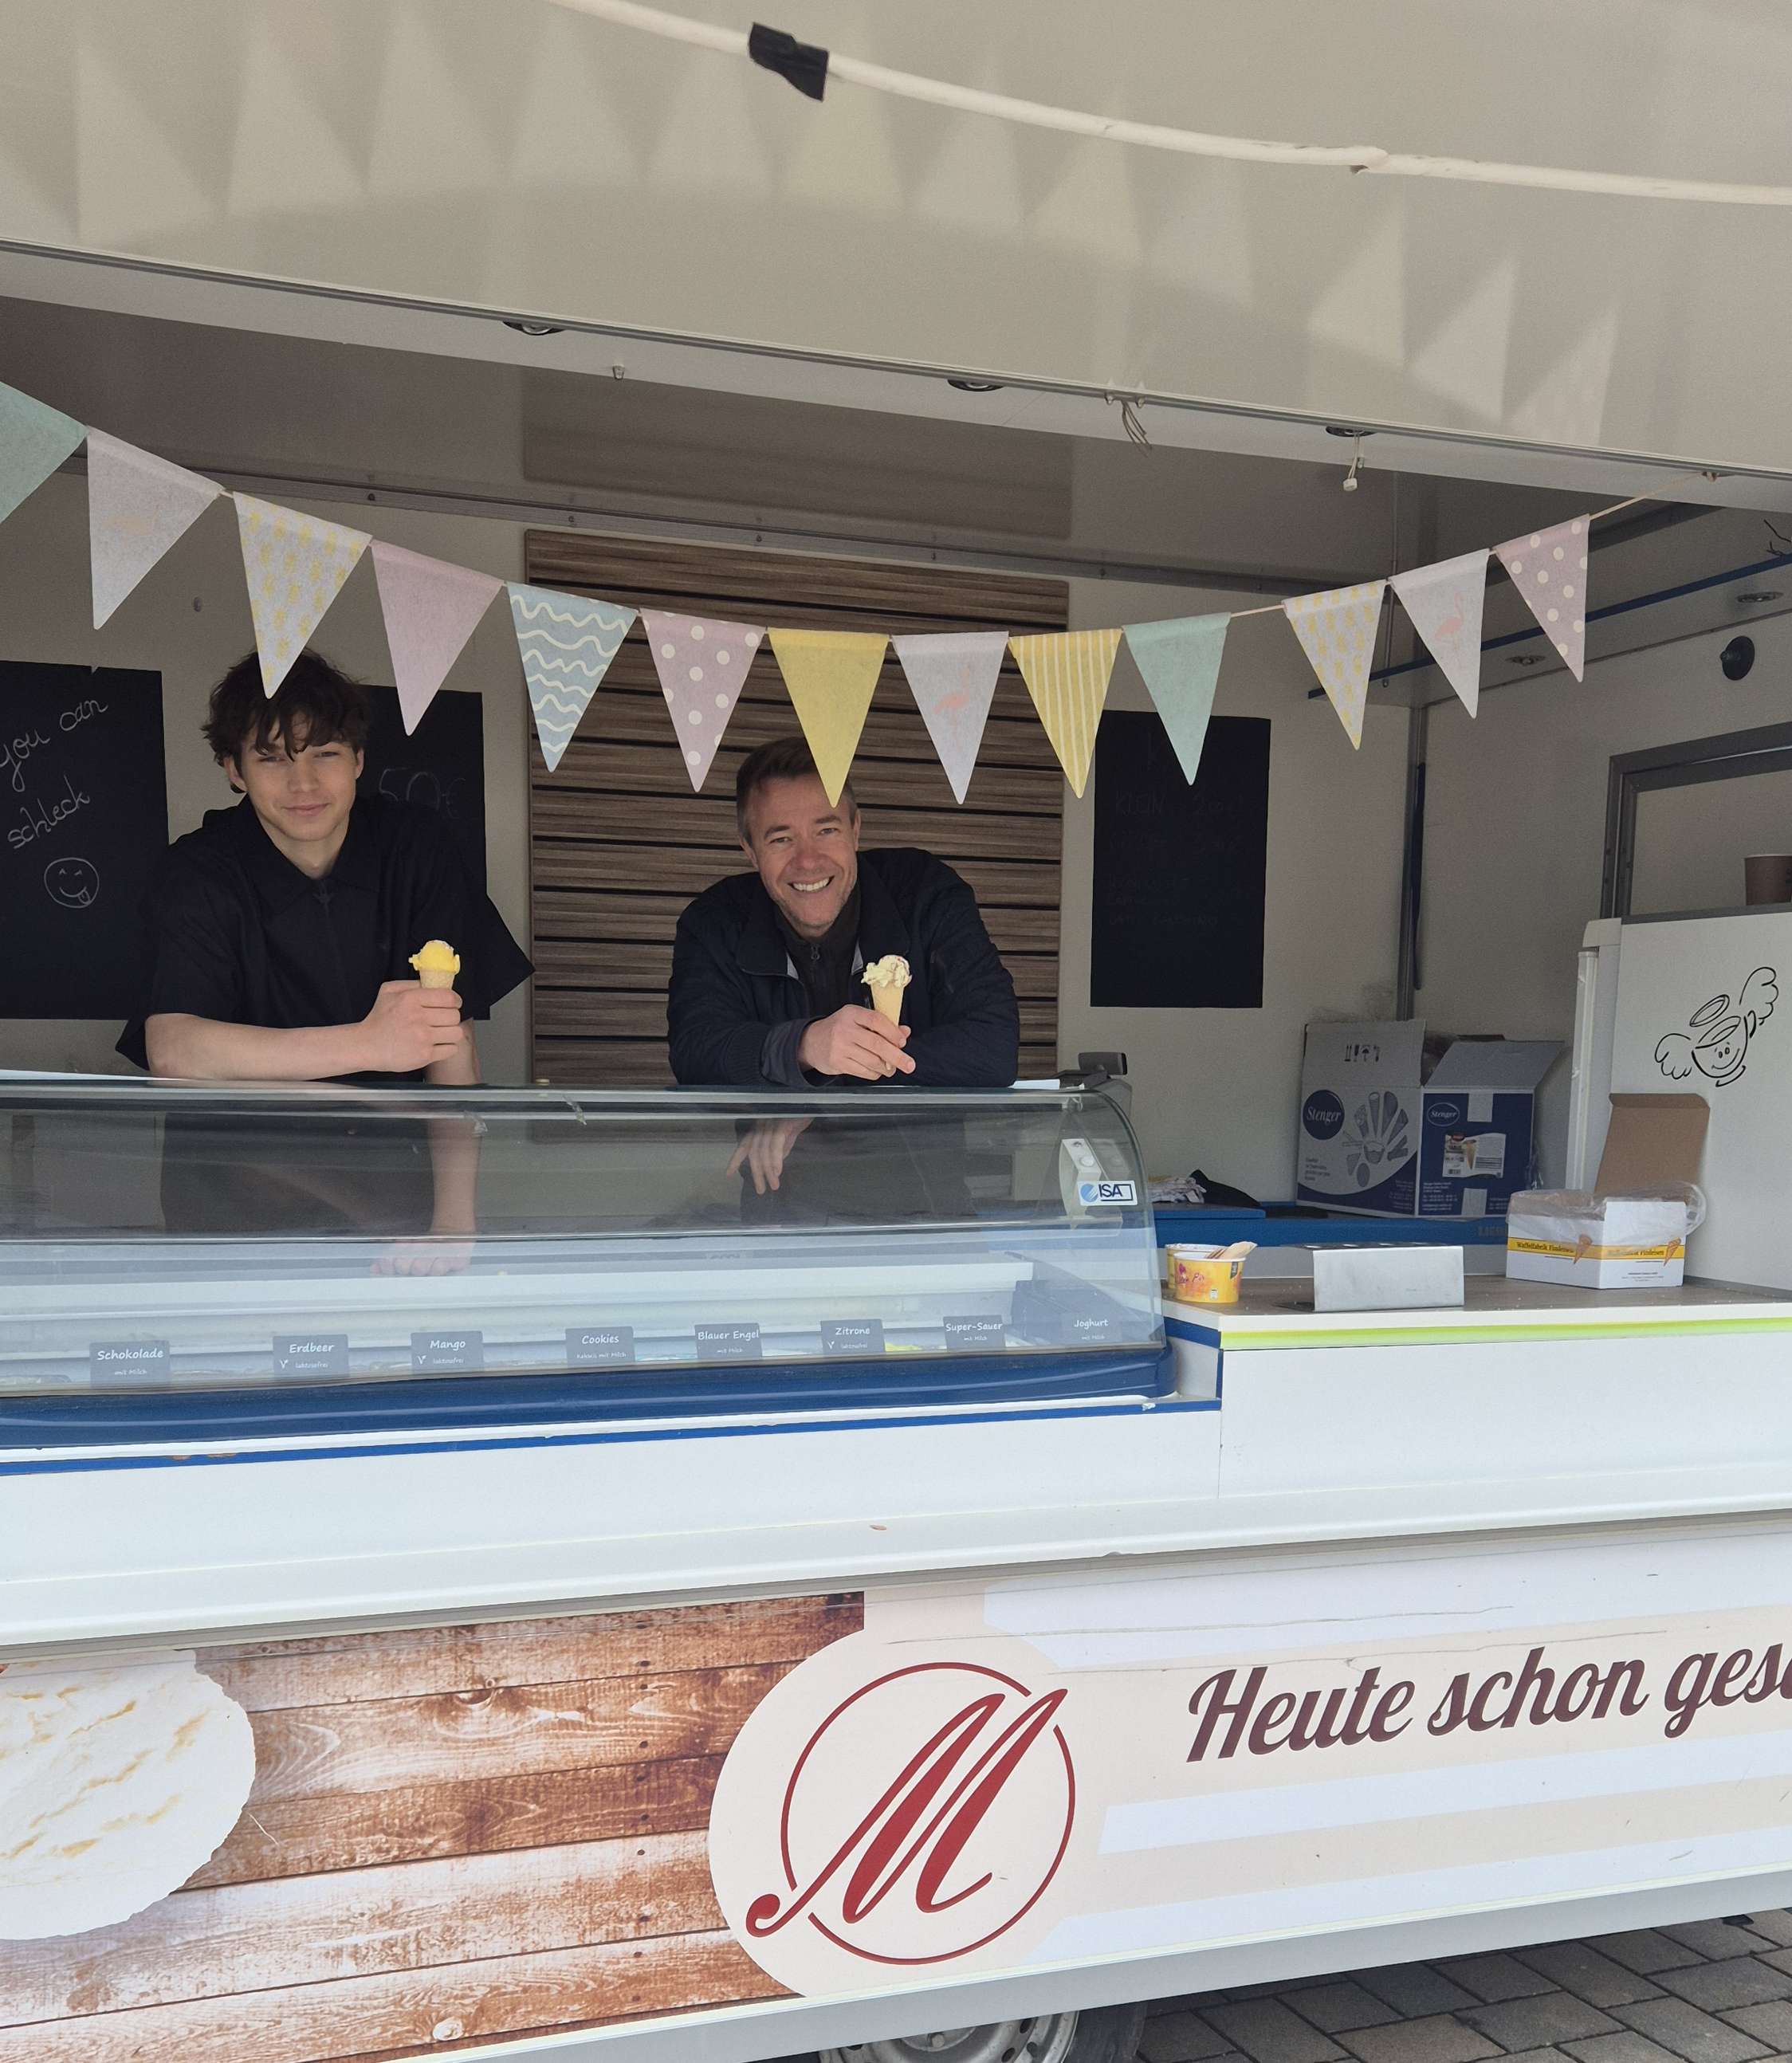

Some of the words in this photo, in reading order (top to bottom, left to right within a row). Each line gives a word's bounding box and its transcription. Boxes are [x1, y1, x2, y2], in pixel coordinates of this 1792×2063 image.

[0, 729, 51, 792] you
[7, 774, 91, 850] schleck
[1307, 1106, 1342, 1123] Stenger
[1098, 1184, 1123, 1198] ISA
[835, 1326, 870, 1335] Zitrone
[945, 1322, 1003, 1334] Super-Sauer
[1074, 1318, 1109, 1330] Joghurt
[581, 1333, 619, 1345] Cookies
[698, 1330, 730, 1340] Blauer
[733, 1329, 760, 1342] Engel
[289, 1342, 334, 1354] Erdbeer
[430, 1340, 466, 1351] Mango
[96, 1347, 164, 1361] Schokolade
[1185, 1666, 1416, 1764] Heute
[1427, 1647, 1649, 1736] schon
